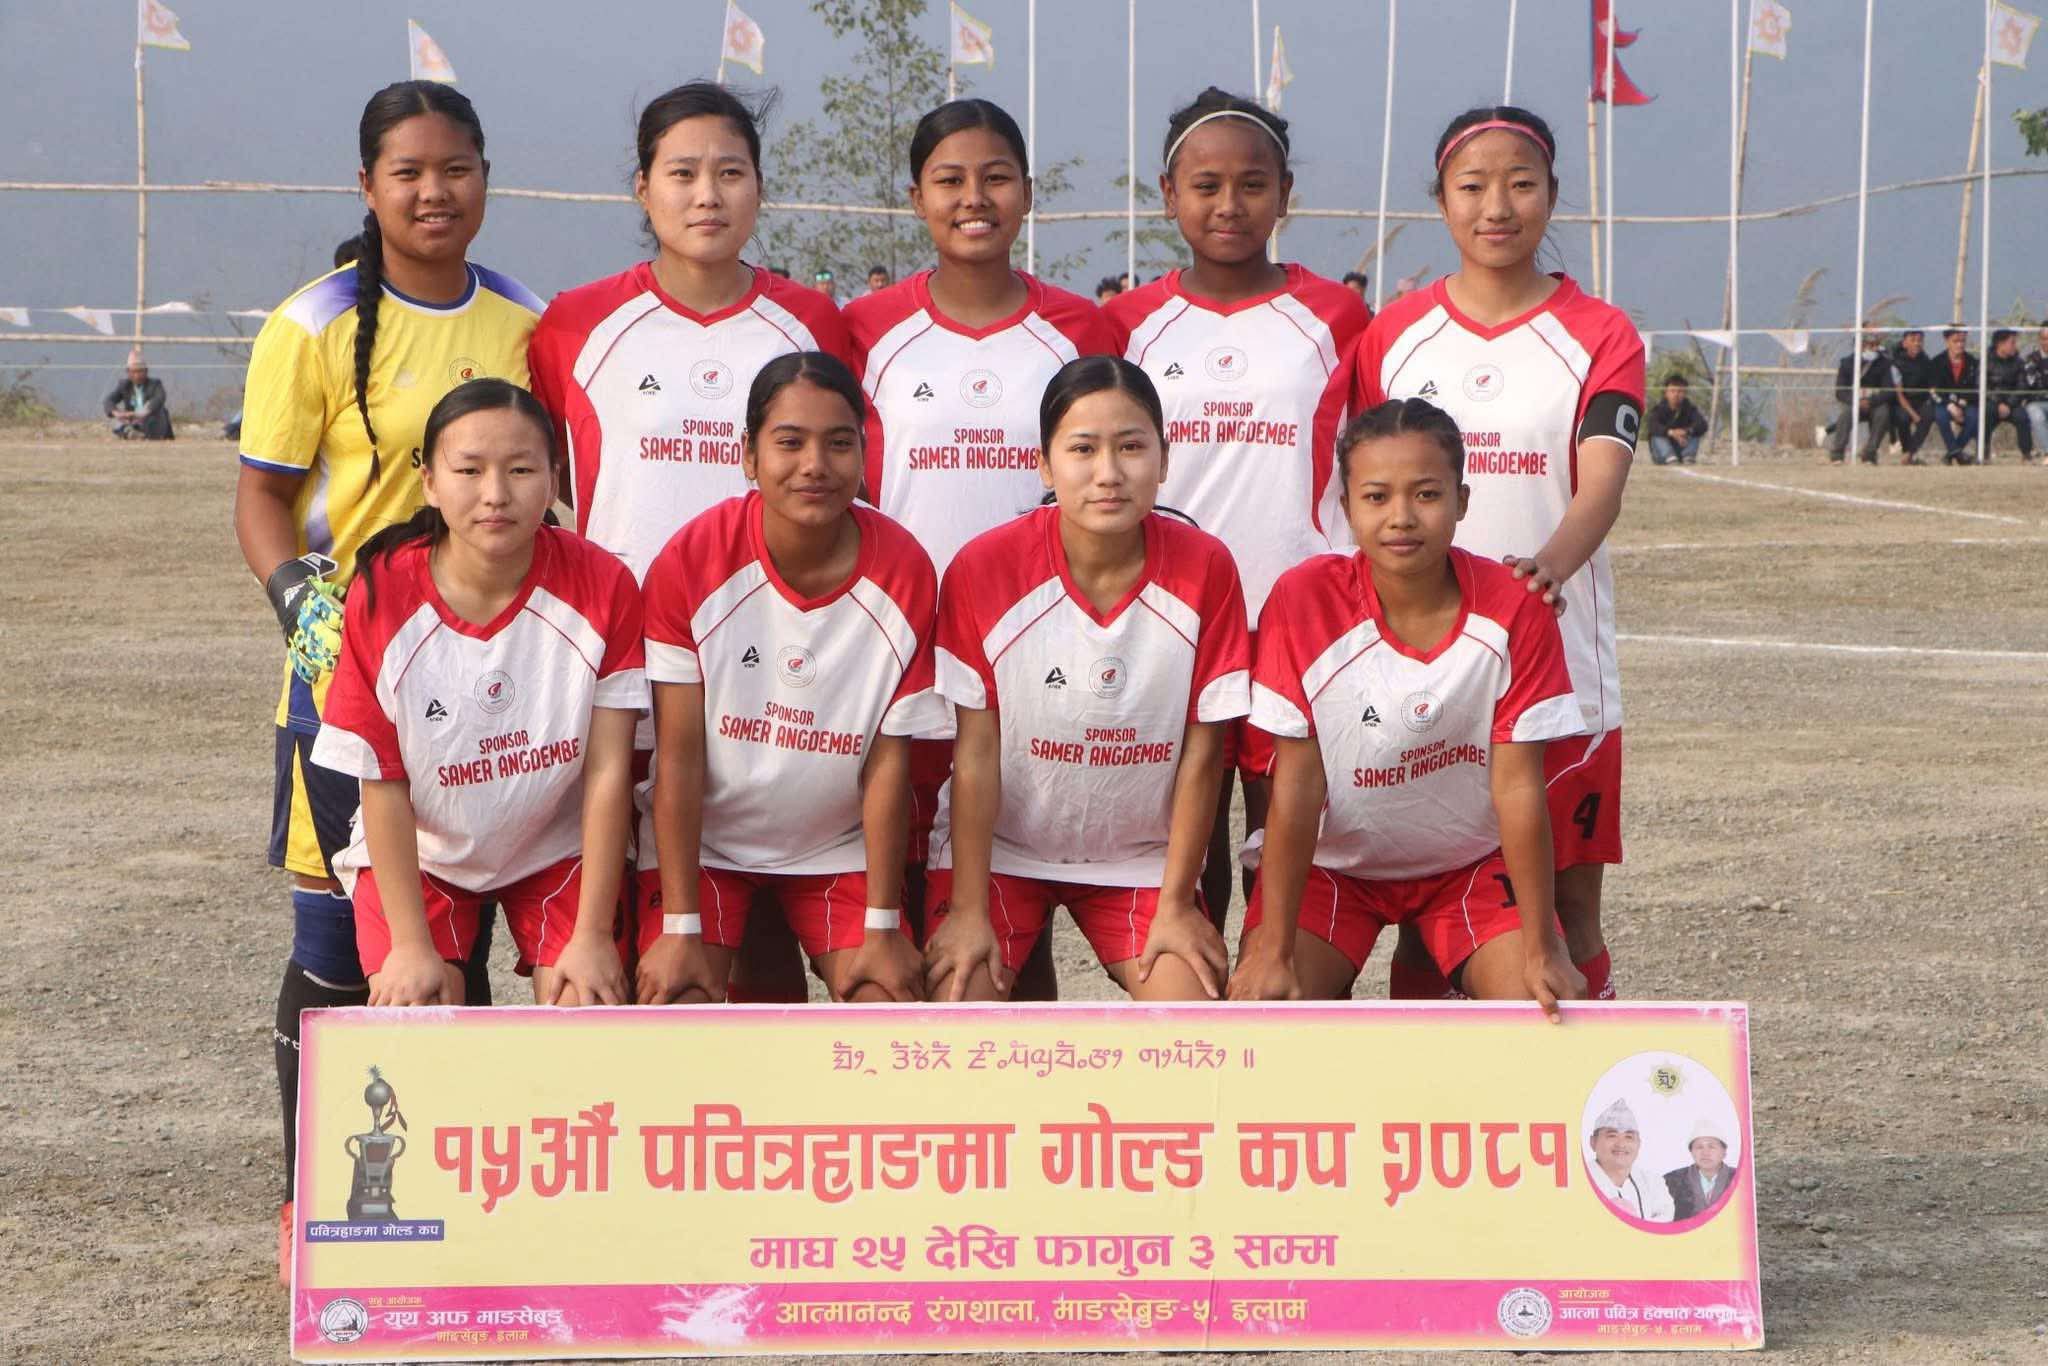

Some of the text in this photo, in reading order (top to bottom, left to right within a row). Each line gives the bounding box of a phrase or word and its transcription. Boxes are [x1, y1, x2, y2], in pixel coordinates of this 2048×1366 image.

[1203, 401, 1253, 417] SPONSOR
[682, 419, 734, 438] SPONSOR
[1166, 420, 1210, 443] AMER
[1616, 404, 1639, 442] C
[954, 428, 1004, 444] SPONSOR
[1461, 431, 1500, 447] PONSOR
[640, 437, 743, 465] SAMER ANGD
[909, 447, 1040, 470] SAMER ANGDEMB
[765, 702, 815, 726] SPONSOR
[719, 715, 771, 744] SAMER
[1084, 728, 1136, 743] SPONSOR
[480, 730, 529, 754] SPONSOR
[1031, 738, 1084, 764] SAMER
[1400, 739, 1446, 763] SPONSOR
[438, 758, 494, 788] SAMER
[1353, 766, 1405, 788] SAMER
[1572, 792, 1602, 840] 4
[640, 1103, 1016, 1204] पवित्रहाङमा
[1040, 1102, 1214, 1193] गोल्ड
[1237, 1122, 1355, 1193] कप
[1382, 1123, 1568, 1208] २०८१
[382, 1223, 413, 1237] गोल्ड
[418, 1225, 439, 1236] कप
[750, 1224, 1339, 1277] माघ २५ देखि फागुन ३ सम्म
[1559, 1287, 1611, 1299] आयोजक
[426, 1311, 472, 1325] अफ
[776, 1300, 912, 1324] आत्मानन्द
[926, 1296, 1039, 1324] रंगशाला,
[1230, 1297, 1307, 1322] इलाम
[1560, 1307, 1600, 1320] आत्मा
[1604, 1304, 1639, 1320] पवित्र
[496, 1329, 528, 1343] इलाम
